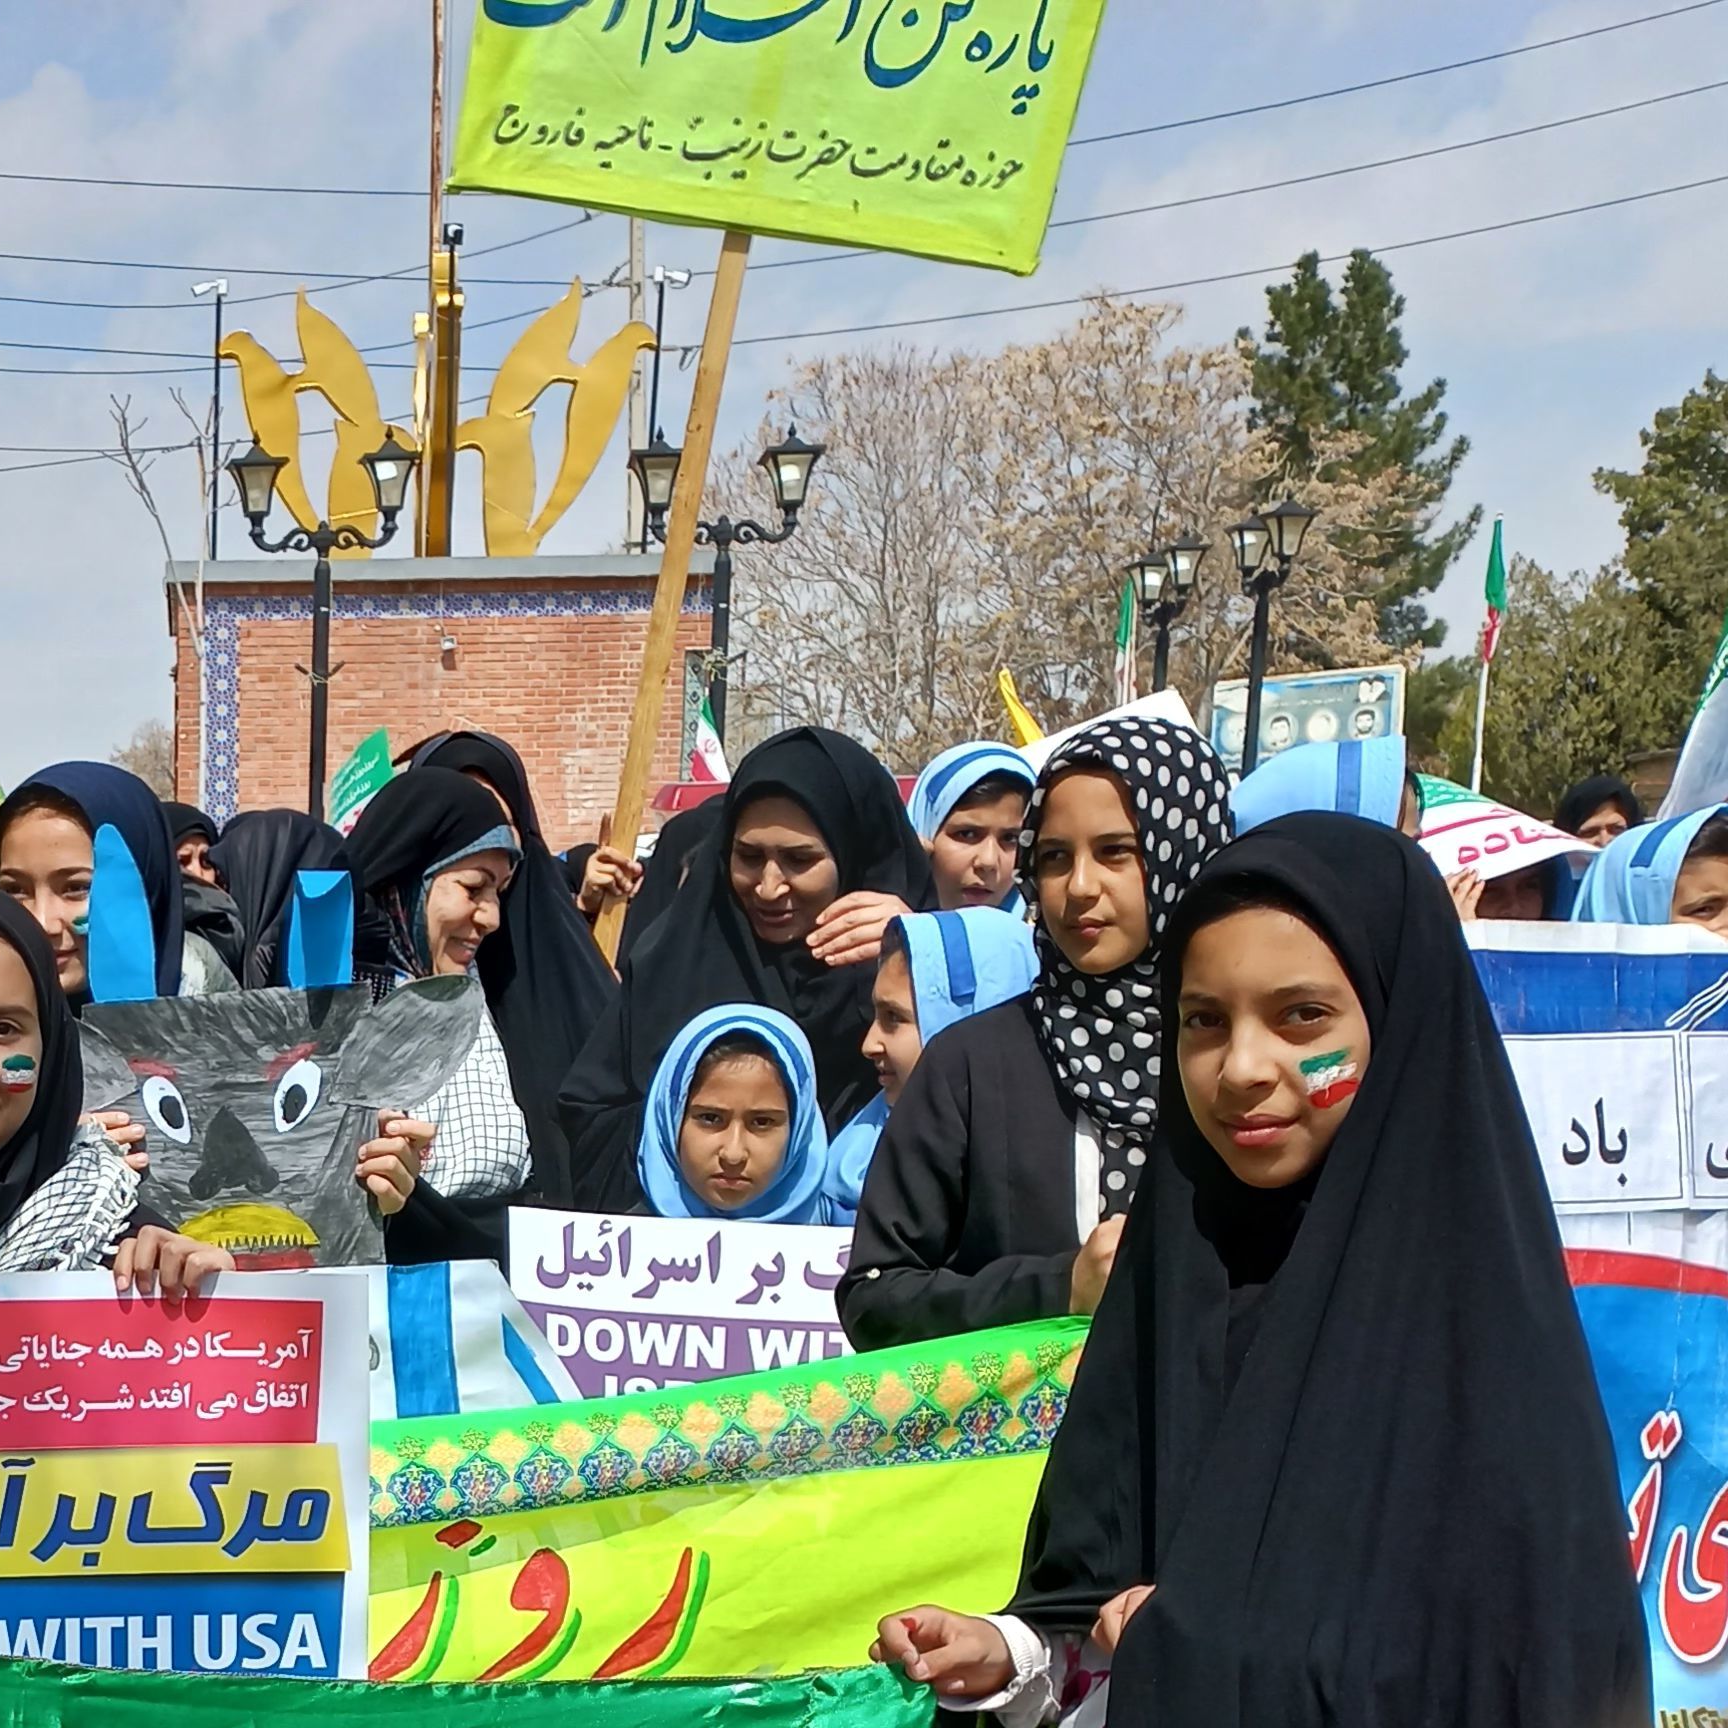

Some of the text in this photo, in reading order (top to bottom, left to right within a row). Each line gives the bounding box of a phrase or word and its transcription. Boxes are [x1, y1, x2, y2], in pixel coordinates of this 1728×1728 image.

[965, 0, 1054, 115] پاره
[494, 103, 586, 147] فاروج
[593, 114, 655, 169] ناحیه
[765, 129, 853, 181] حضرت
[849, 138, 965, 182] مقاومت
[959, 150, 1024, 190] حوزه
[1561, 1097, 1629, 1188] باد
[536, 1218, 722, 1300] اسرائیل
[735, 1251, 786, 1305] بر
[98, 1336, 165, 1361] همه
[167, 1336, 201, 1365] در
[204, 1328, 314, 1370] آمریکا
[546, 1312, 854, 1373] DOWN WIT
[138, 1380, 192, 1410] افتد
[196, 1391, 238, 1421] می
[242, 1380, 309, 1415] اتفاق
[29, 1490, 118, 1569] بر
[126, 1460, 332, 1559] مرگ
[369, 1519, 710, 1682] روز
[192, 1612, 328, 1671] USA
